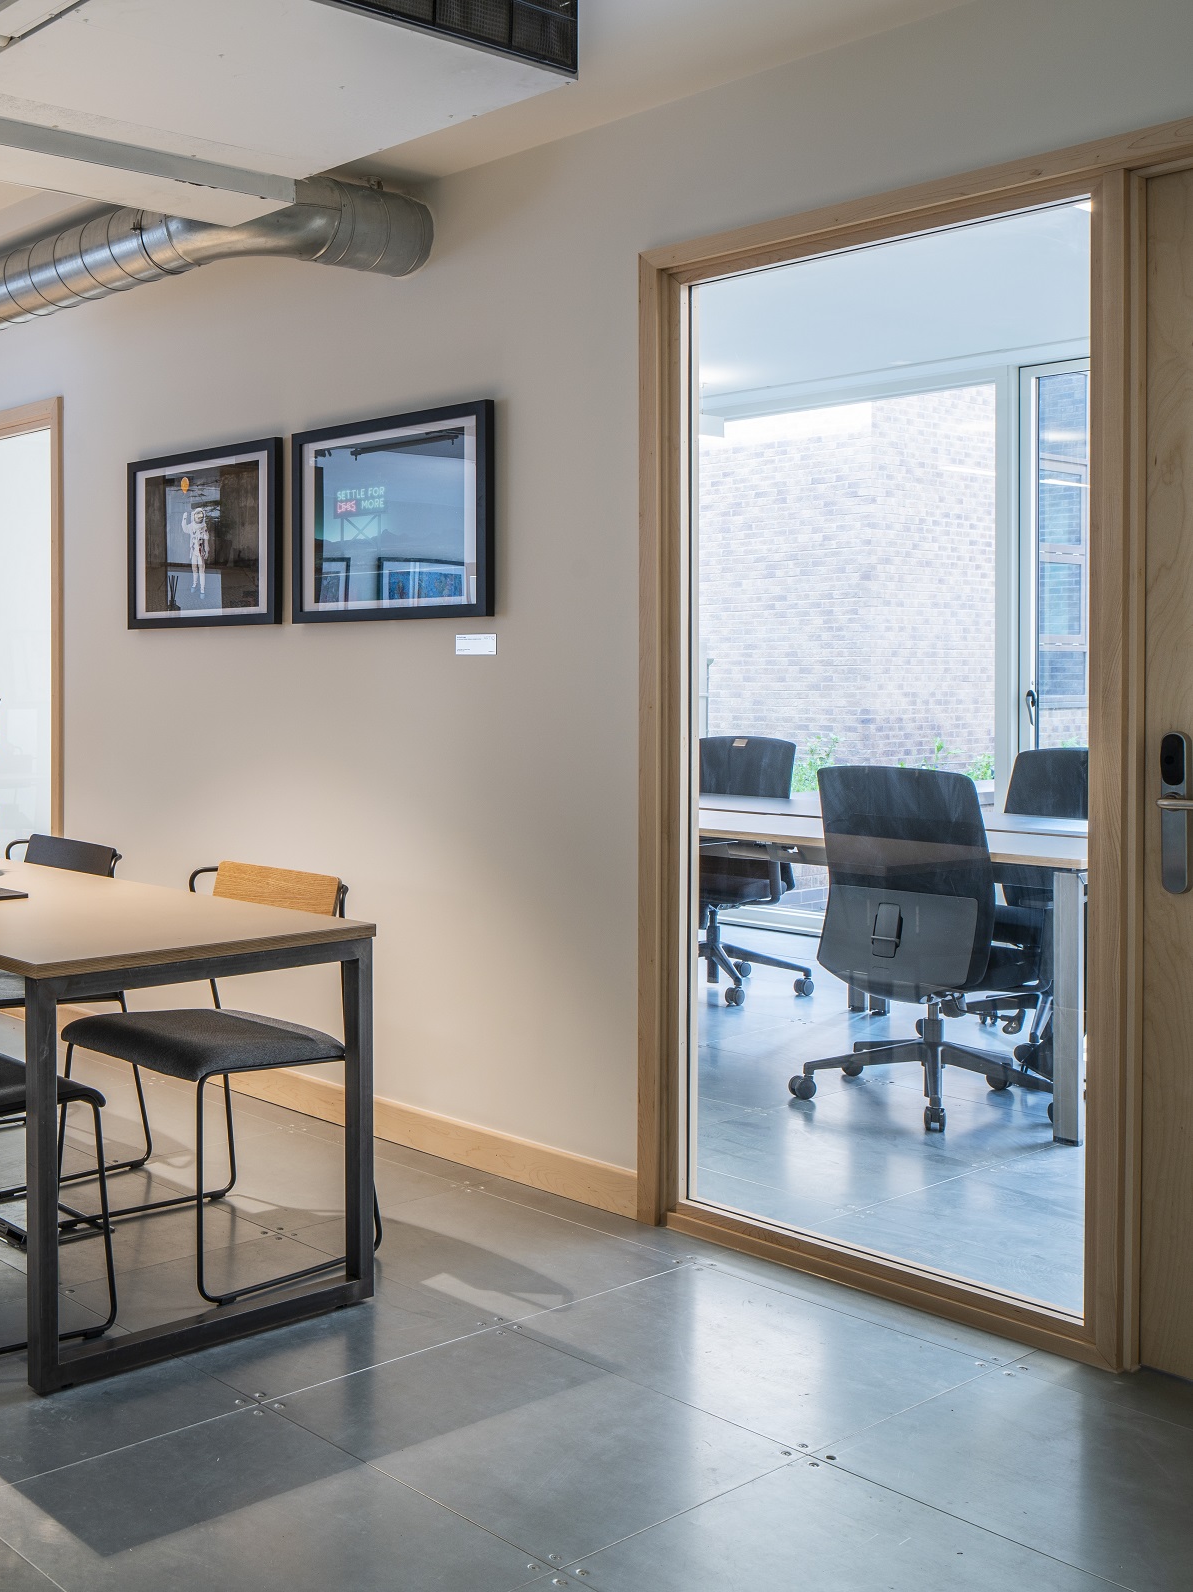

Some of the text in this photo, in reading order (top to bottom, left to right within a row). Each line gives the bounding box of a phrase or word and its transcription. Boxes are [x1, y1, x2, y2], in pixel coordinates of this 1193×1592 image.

[337, 486, 385, 500] SETTLE FOR
[361, 498, 385, 509] MORE
